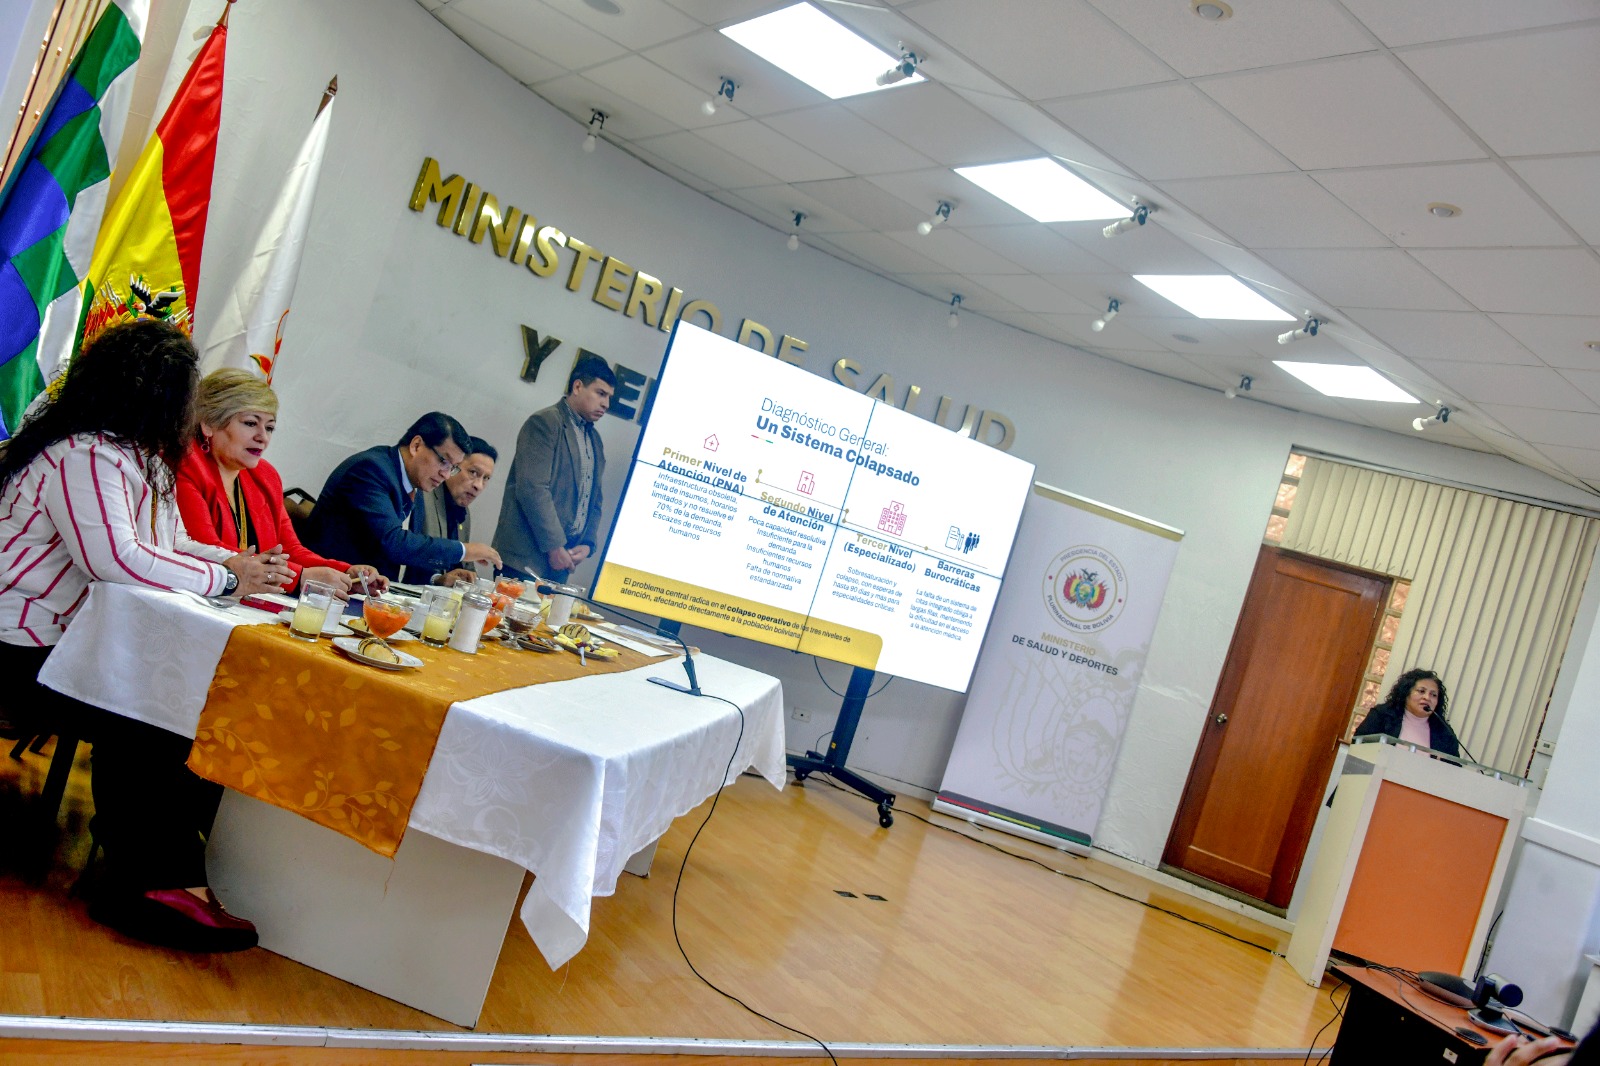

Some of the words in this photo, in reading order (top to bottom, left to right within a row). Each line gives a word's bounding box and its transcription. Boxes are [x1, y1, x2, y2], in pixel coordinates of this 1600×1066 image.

[520, 324, 563, 383] Y
[761, 397, 836, 437] Diagnóstico
[838, 428, 890, 458] General:
[756, 415, 778, 434] Un
[780, 424, 844, 459] Sistema
[845, 449, 920, 487] Colapsado
[663, 447, 702, 467] Primer
[703, 460, 732, 477] Nivel
[733, 471, 747, 482] de
[657, 460, 710, 483] Atención
[712, 476, 744, 496] (PNA)
[658, 472, 708, 494] Infraestructura
[651, 490, 682, 505] limitados
[699, 506, 726, 520] resuelve
[653, 481, 668, 491] falta
[669, 485, 678, 494] de
[711, 499, 738, 512] horarios
[657, 502, 672, 512] 70%
[674, 508, 682, 516] de
[761, 491, 806, 513] Segundo
[807, 507, 834, 522] Nivel
[683, 520, 691, 528] de
[692, 523, 721, 537] recursos
[748, 516, 764, 526] Poca
[766, 522, 797, 537] capacidad
[798, 533, 826, 545] resolutiva
[763, 506, 776, 516] de
[778, 510, 824, 532] Atención
[669, 526, 700, 540] humanos
[792, 540, 806, 549] para
[807, 543, 813, 551] la
[856, 533, 888, 550] Tercer
[888, 544, 913, 558] Nivel
[768, 542, 796, 555] demanda
[844, 542, 916, 573] (Especializado)
[746, 563, 761, 572] Falta
[772, 571, 802, 584] normativa
[763, 558, 791, 572] humanos
[786, 557, 812, 569] recursos
[937, 560, 975, 579] Barreras
[1060, 548, 1098, 562] PRESIDENCIA
[1099, 551, 1109, 562] DEL
[1109, 559, 1124, 582] ESTADO
[750, 575, 792, 591] estandarizada
[833, 580, 849, 590] hasta
[861, 580, 872, 588] con
[873, 584, 894, 595] esperas
[924, 568, 980, 592] Burocráticas
[623, 577, 632, 585] El
[632, 581, 665, 594] problema
[666, 589, 690, 600] central
[690, 596, 710, 606] radica
[727, 605, 756, 618] colapso
[757, 613, 791, 627] operativo
[792, 622, 800, 630] de
[810, 627, 822, 635] tres
[822, 630, 842, 642] niveles
[843, 635, 851, 643] de
[832, 590, 874, 606] especialidades
[654, 596, 688, 610] afectando
[688, 604, 730, 621] directamente
[736, 616, 742, 624] la
[743, 618, 773, 632] población
[1048, 595, 1082, 630] PLURINACIONAL
[1092, 614, 1114, 629] BOLIVIA
[1012, 634, 1024, 645] DE
[1026, 640, 1059, 656] SALUD
[1069, 653, 1119, 676] DEPORTES
[1041, 632, 1097, 656] MINISTERIO
